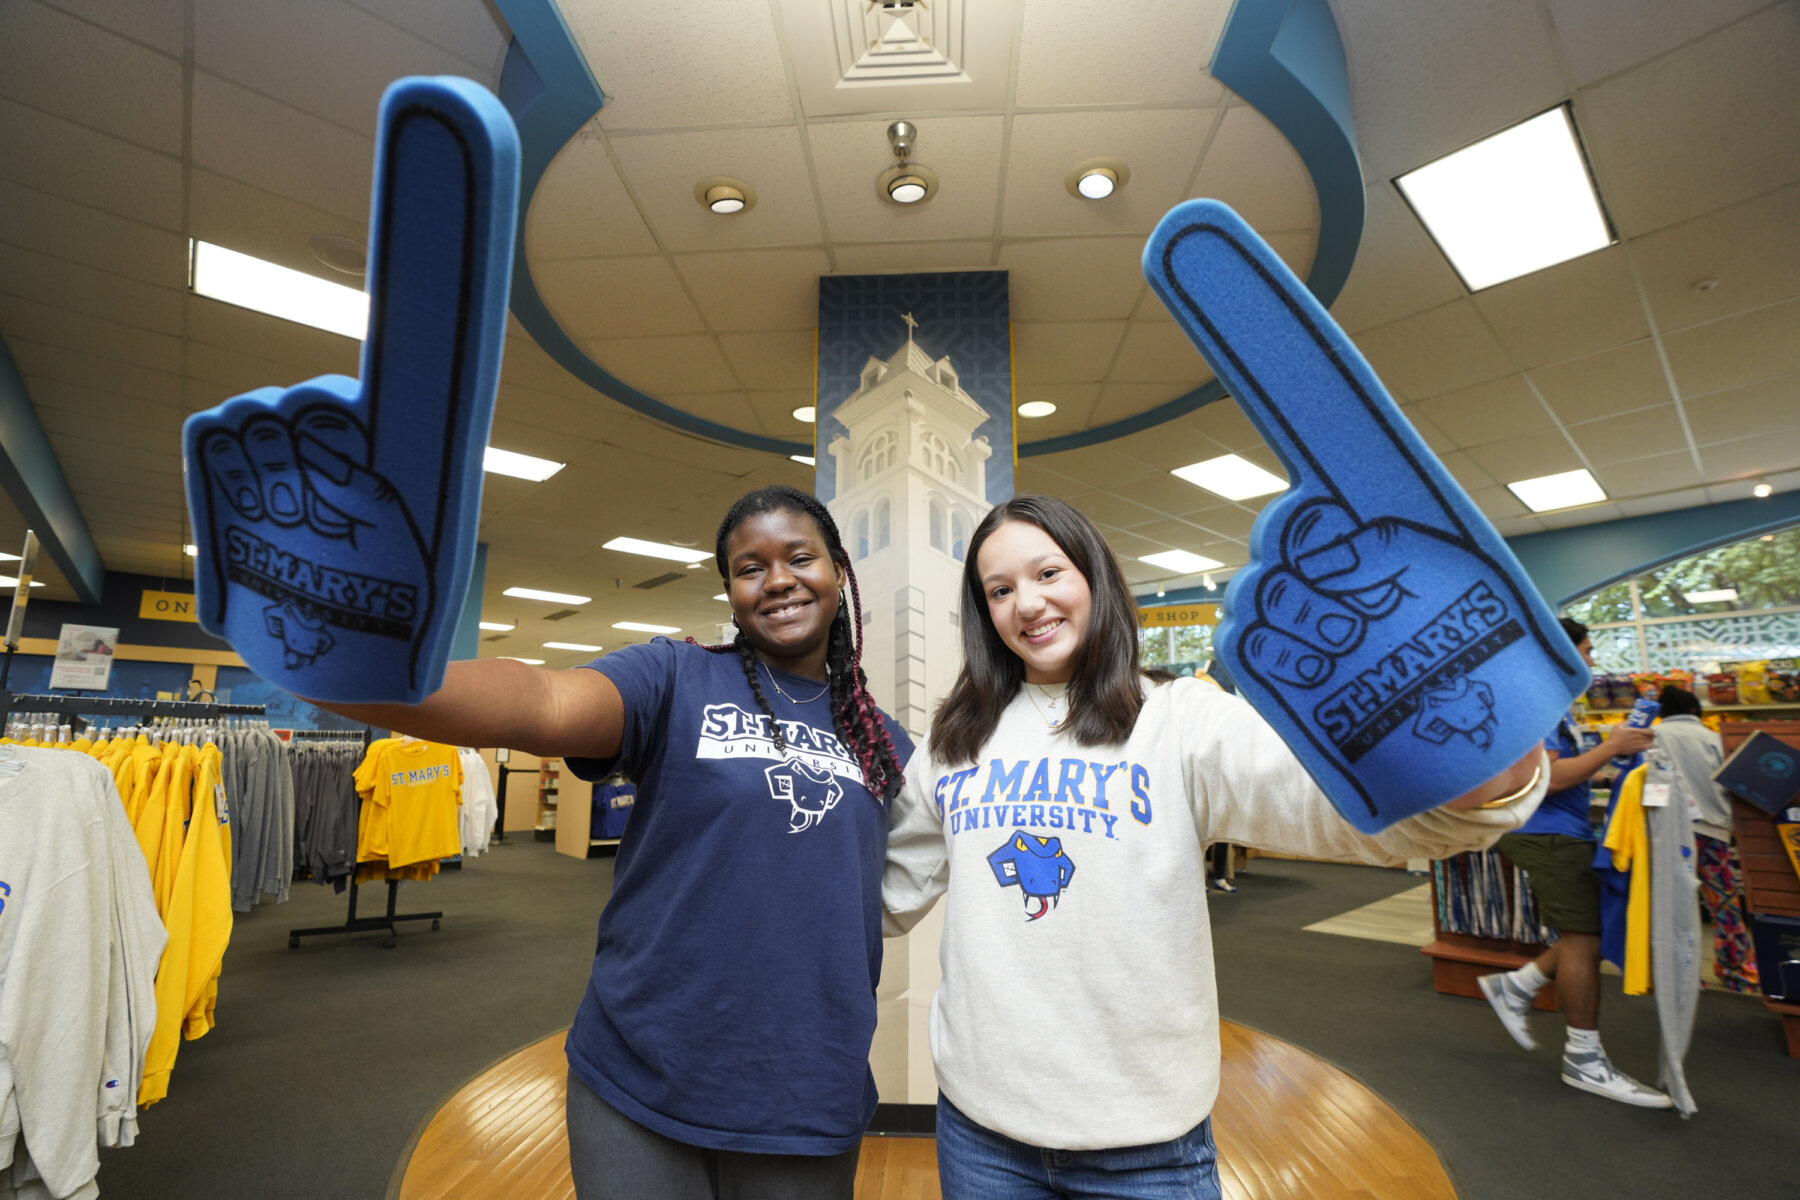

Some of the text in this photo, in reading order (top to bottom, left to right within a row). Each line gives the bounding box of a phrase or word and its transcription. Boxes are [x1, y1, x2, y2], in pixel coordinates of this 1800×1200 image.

[1156, 611, 1200, 622] SHOP
[980, 757, 1153, 827] MARY'S
[950, 804, 1119, 839] UNIVERSITY
